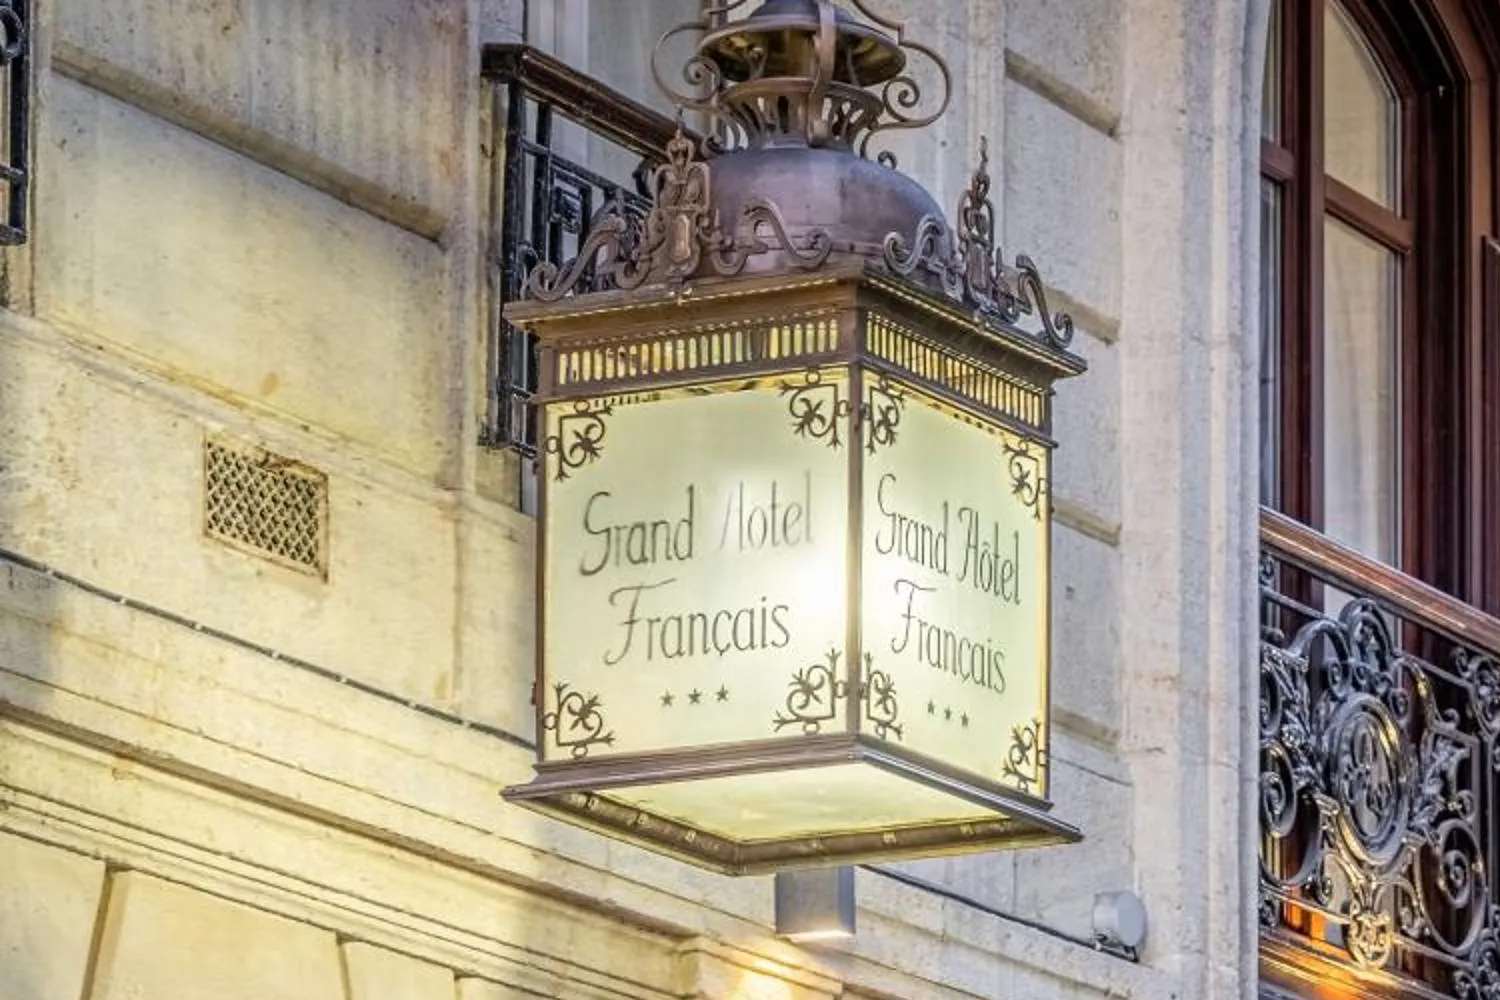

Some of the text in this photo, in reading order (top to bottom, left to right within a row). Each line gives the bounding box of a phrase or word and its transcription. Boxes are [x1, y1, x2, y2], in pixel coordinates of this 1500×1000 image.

[580, 483, 694, 576] Grand
[876, 473, 1021, 605] Grand Hôtel
[604, 578, 791, 665] Français
[891, 579, 1006, 694] Français
